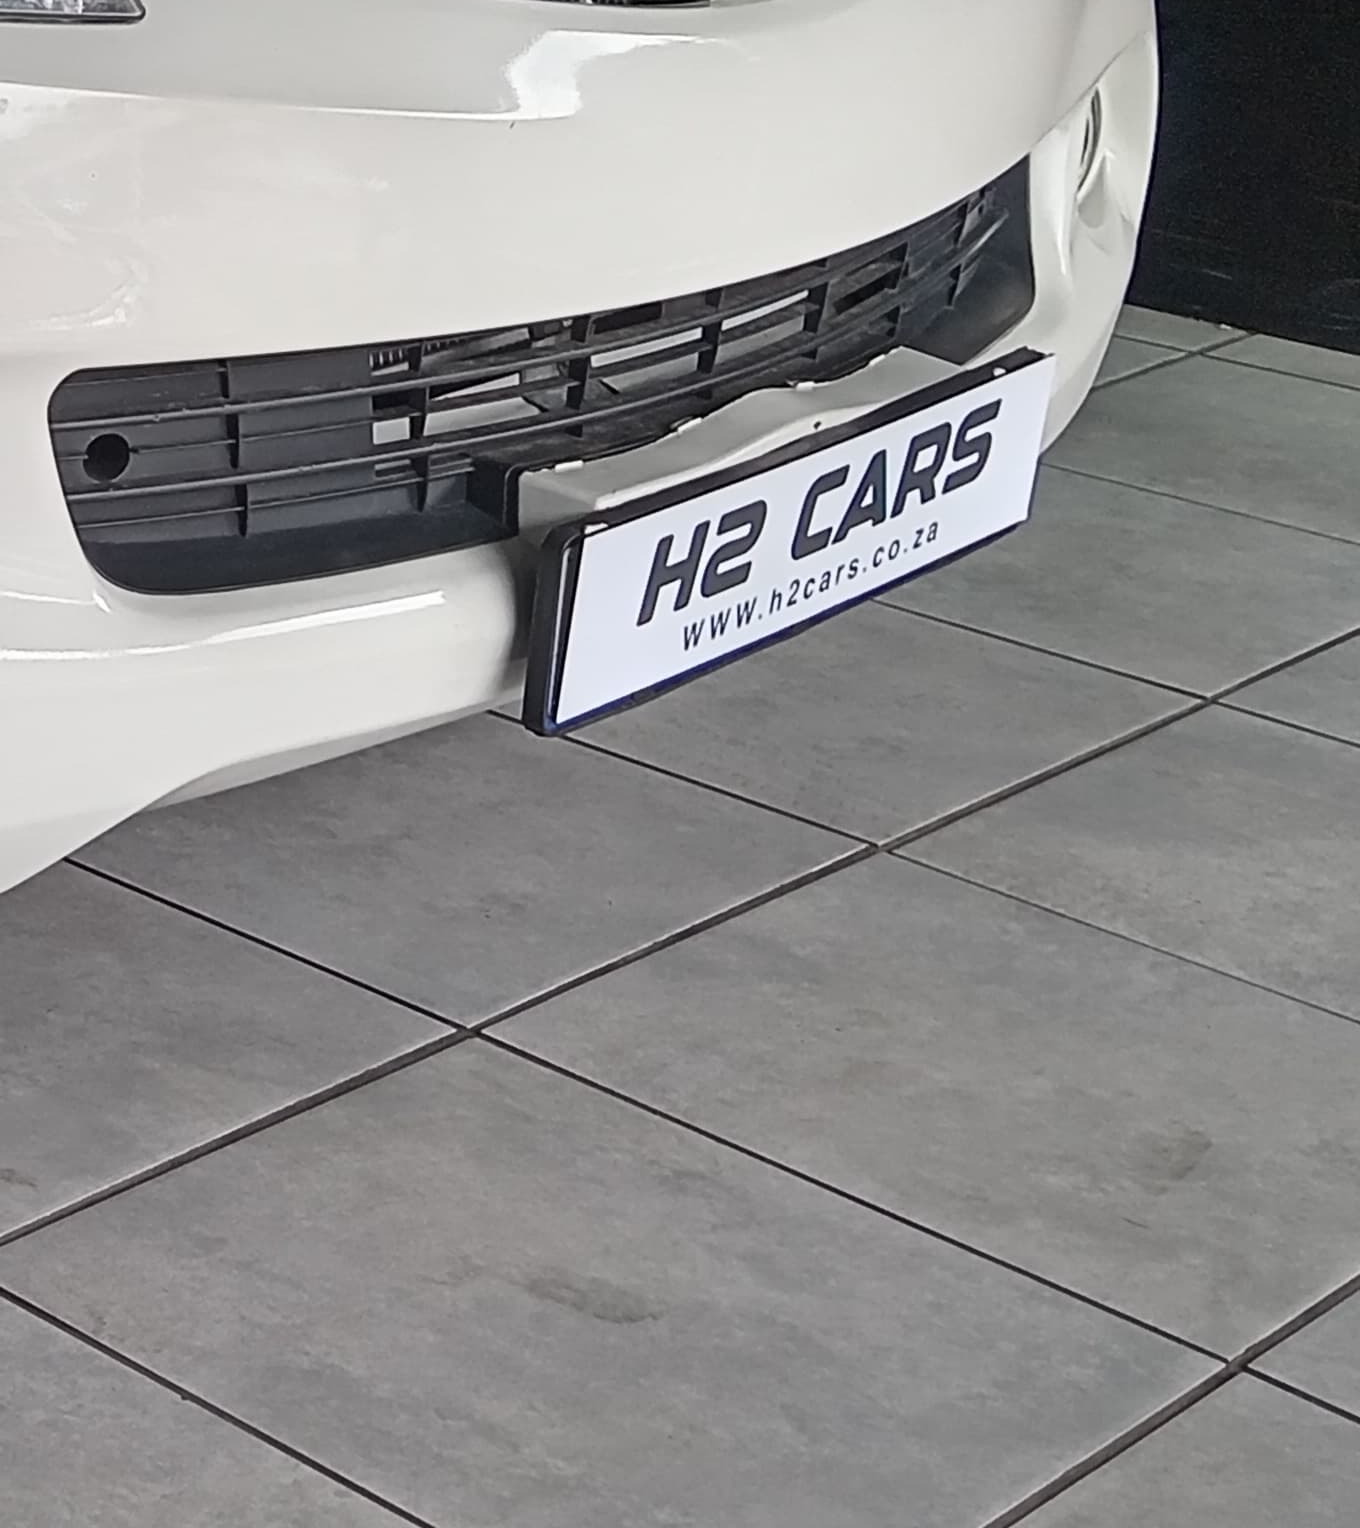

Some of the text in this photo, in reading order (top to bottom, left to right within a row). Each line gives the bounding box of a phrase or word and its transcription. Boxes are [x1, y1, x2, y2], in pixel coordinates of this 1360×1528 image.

[637, 400, 1001, 625] H2 CARS
[683, 522, 939, 650] www.h2cars.co.za
